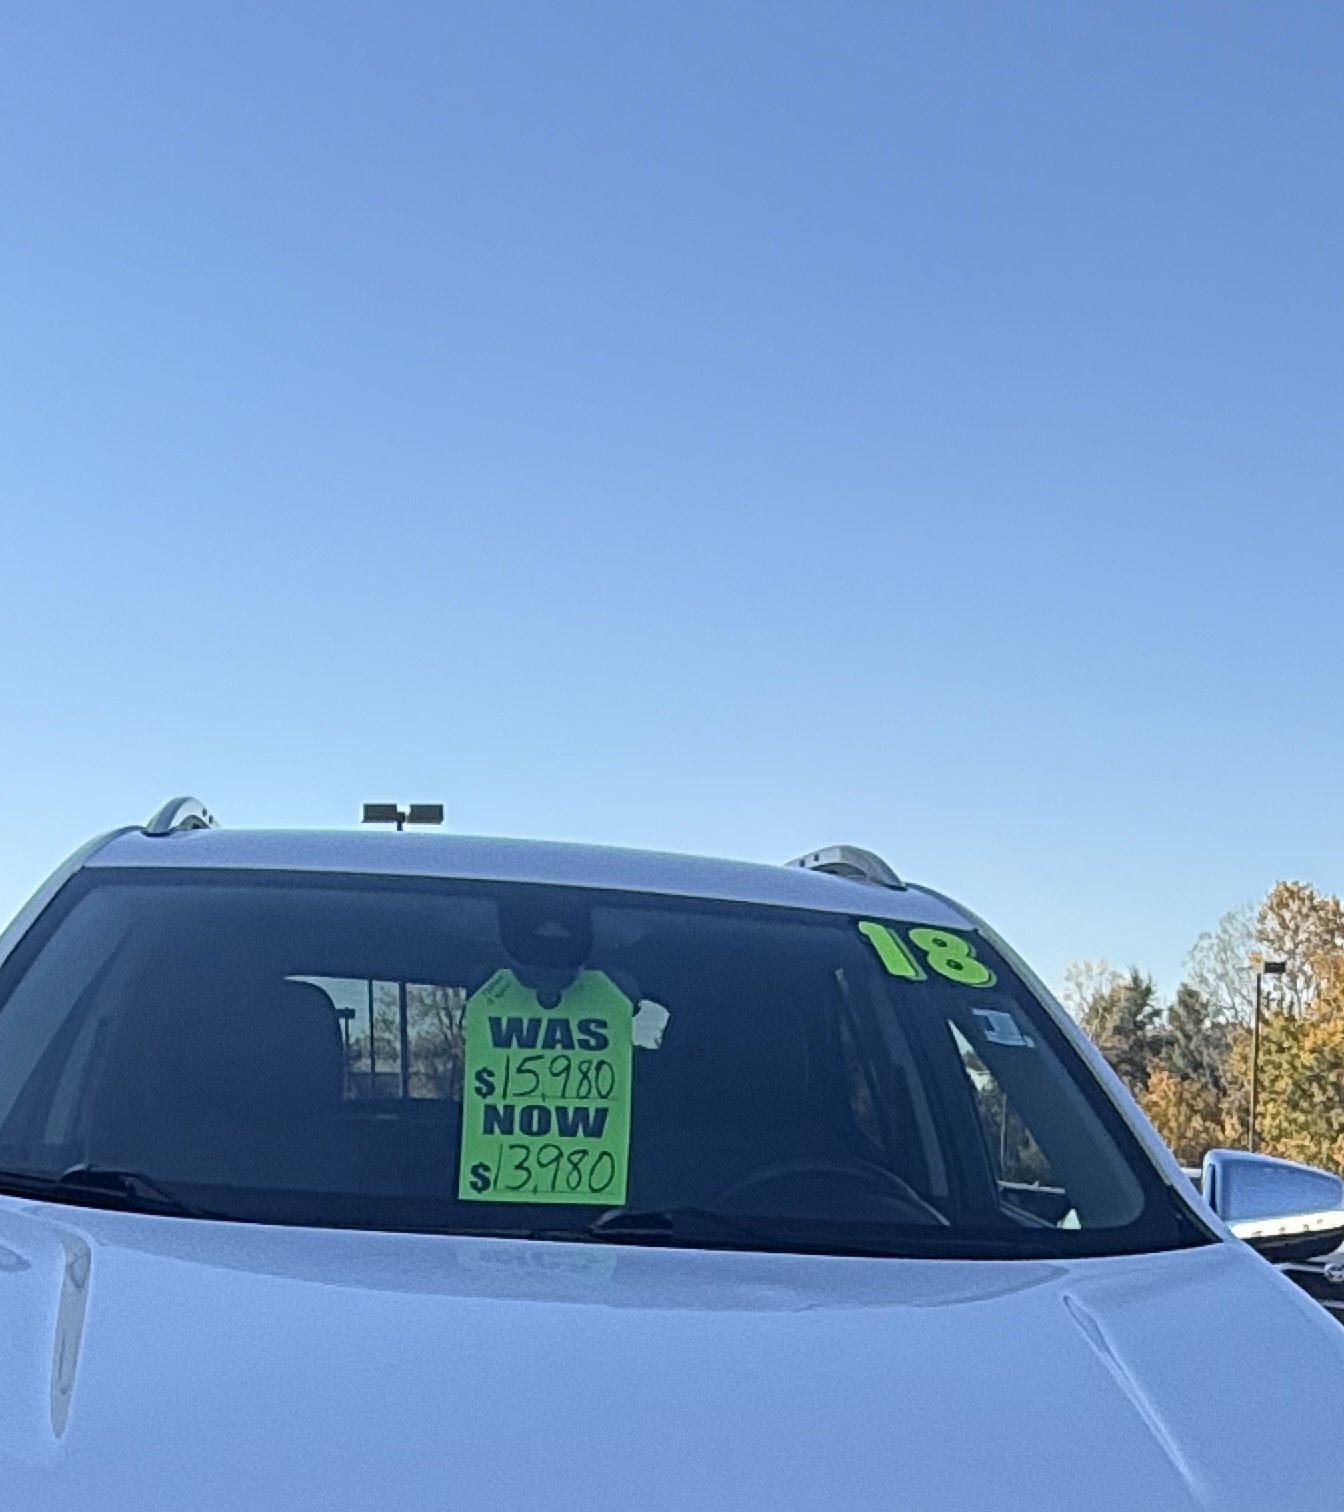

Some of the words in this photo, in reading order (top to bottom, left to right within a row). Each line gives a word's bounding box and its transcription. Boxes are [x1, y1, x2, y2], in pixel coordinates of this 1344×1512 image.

[858, 920, 997, 988] 18
[488, 1016, 609, 1050] WAS
[482, 1104, 609, 1138] NOW
